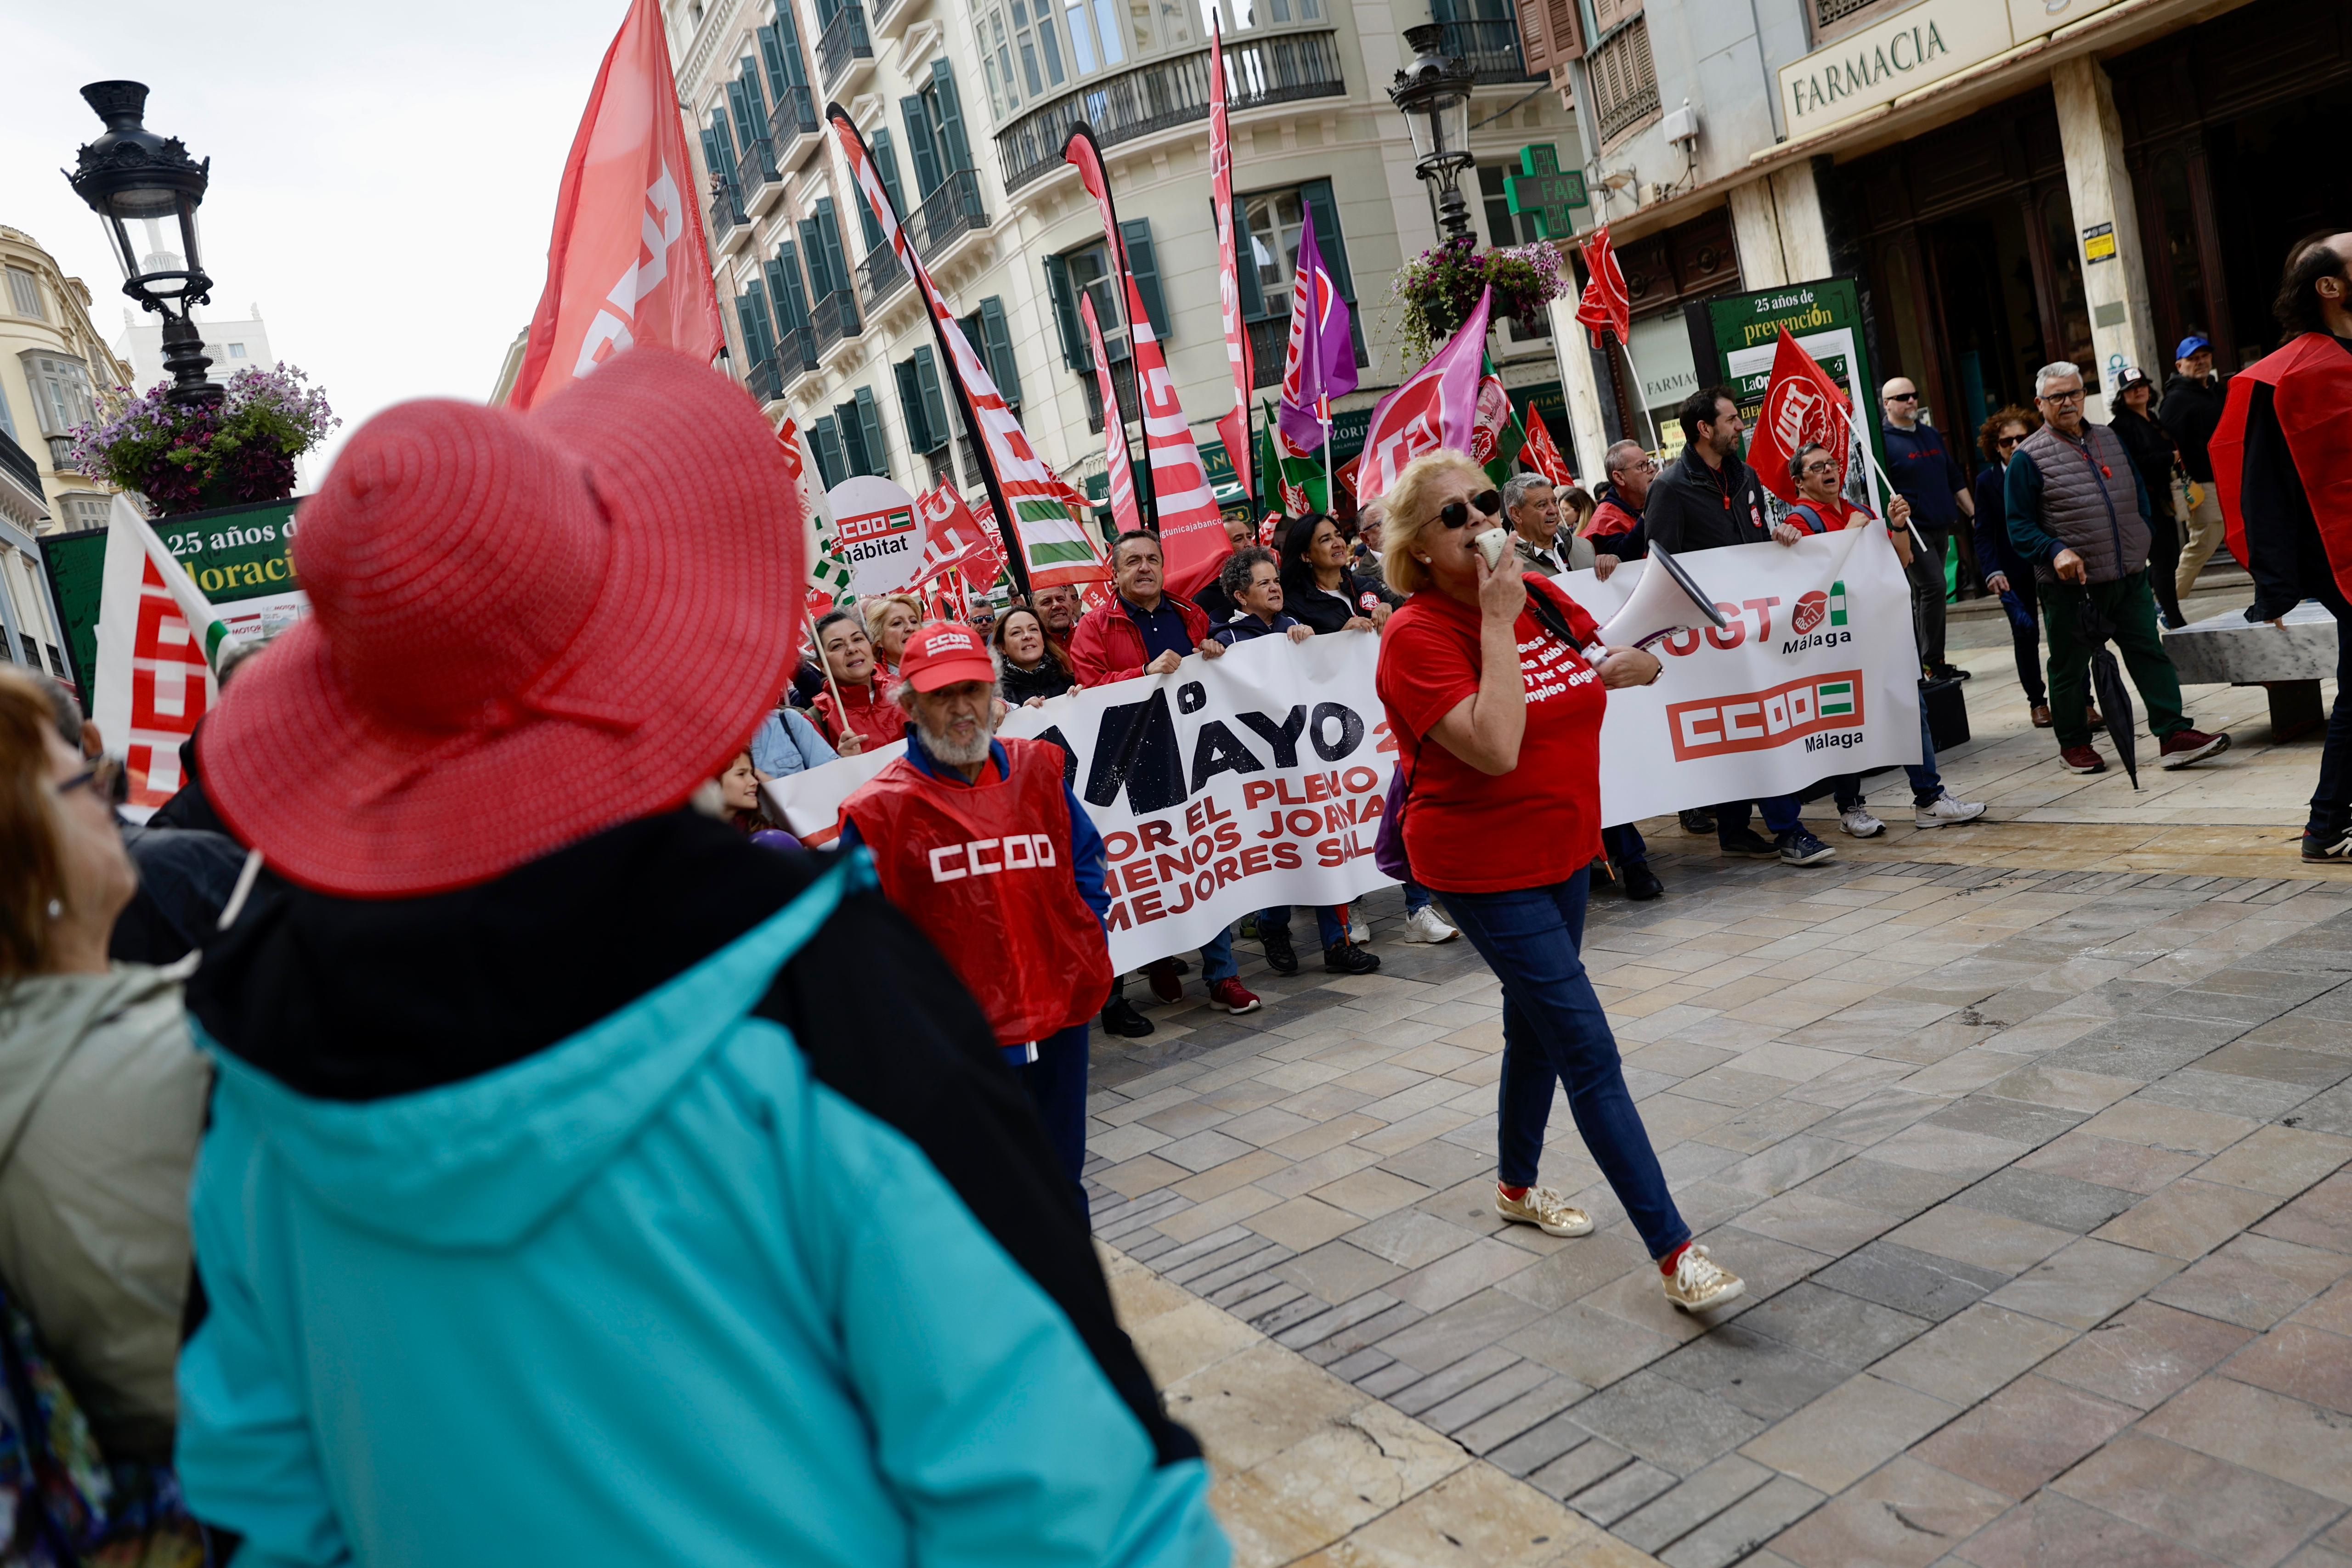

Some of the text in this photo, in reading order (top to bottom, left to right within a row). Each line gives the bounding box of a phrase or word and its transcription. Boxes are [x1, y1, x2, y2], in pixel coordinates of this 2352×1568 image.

[1791, 18, 1948, 117] FARMACIA
[1541, 179, 1582, 201] FAR
[1755, 288, 1814, 313] 25 años de
[1744, 303, 1833, 346] prevención
[1647, 370, 1699, 395] FARMAC
[1775, 382, 1815, 451] UGT
[1333, 424, 1369, 441] ZORIT
[1334, 440, 1363, 450] SALAMANC
[168, 514, 298, 556] 25 años d
[838, 515, 887, 540] COO
[182, 548, 298, 592] loraci
[1361, 594, 1379, 605] UGT
[925, 632, 971, 650] CCOO
[1517, 636, 1547, 654] ensa
[1538, 639, 1570, 666] públ
[1782, 631, 1852, 654] Málaga
[1523, 660, 1577, 687] y por un
[1525, 682, 1566, 704] mpleo
[1679, 686, 1816, 748] CCOO
[1805, 731, 1864, 754] Málaga
[1102, 766, 1378, 862] OR EL PLENO
[1257, 794, 1385, 839] JORNA
[928, 834, 1056, 883] CCOO
[1105, 830, 1376, 933] MEJORES SAL
